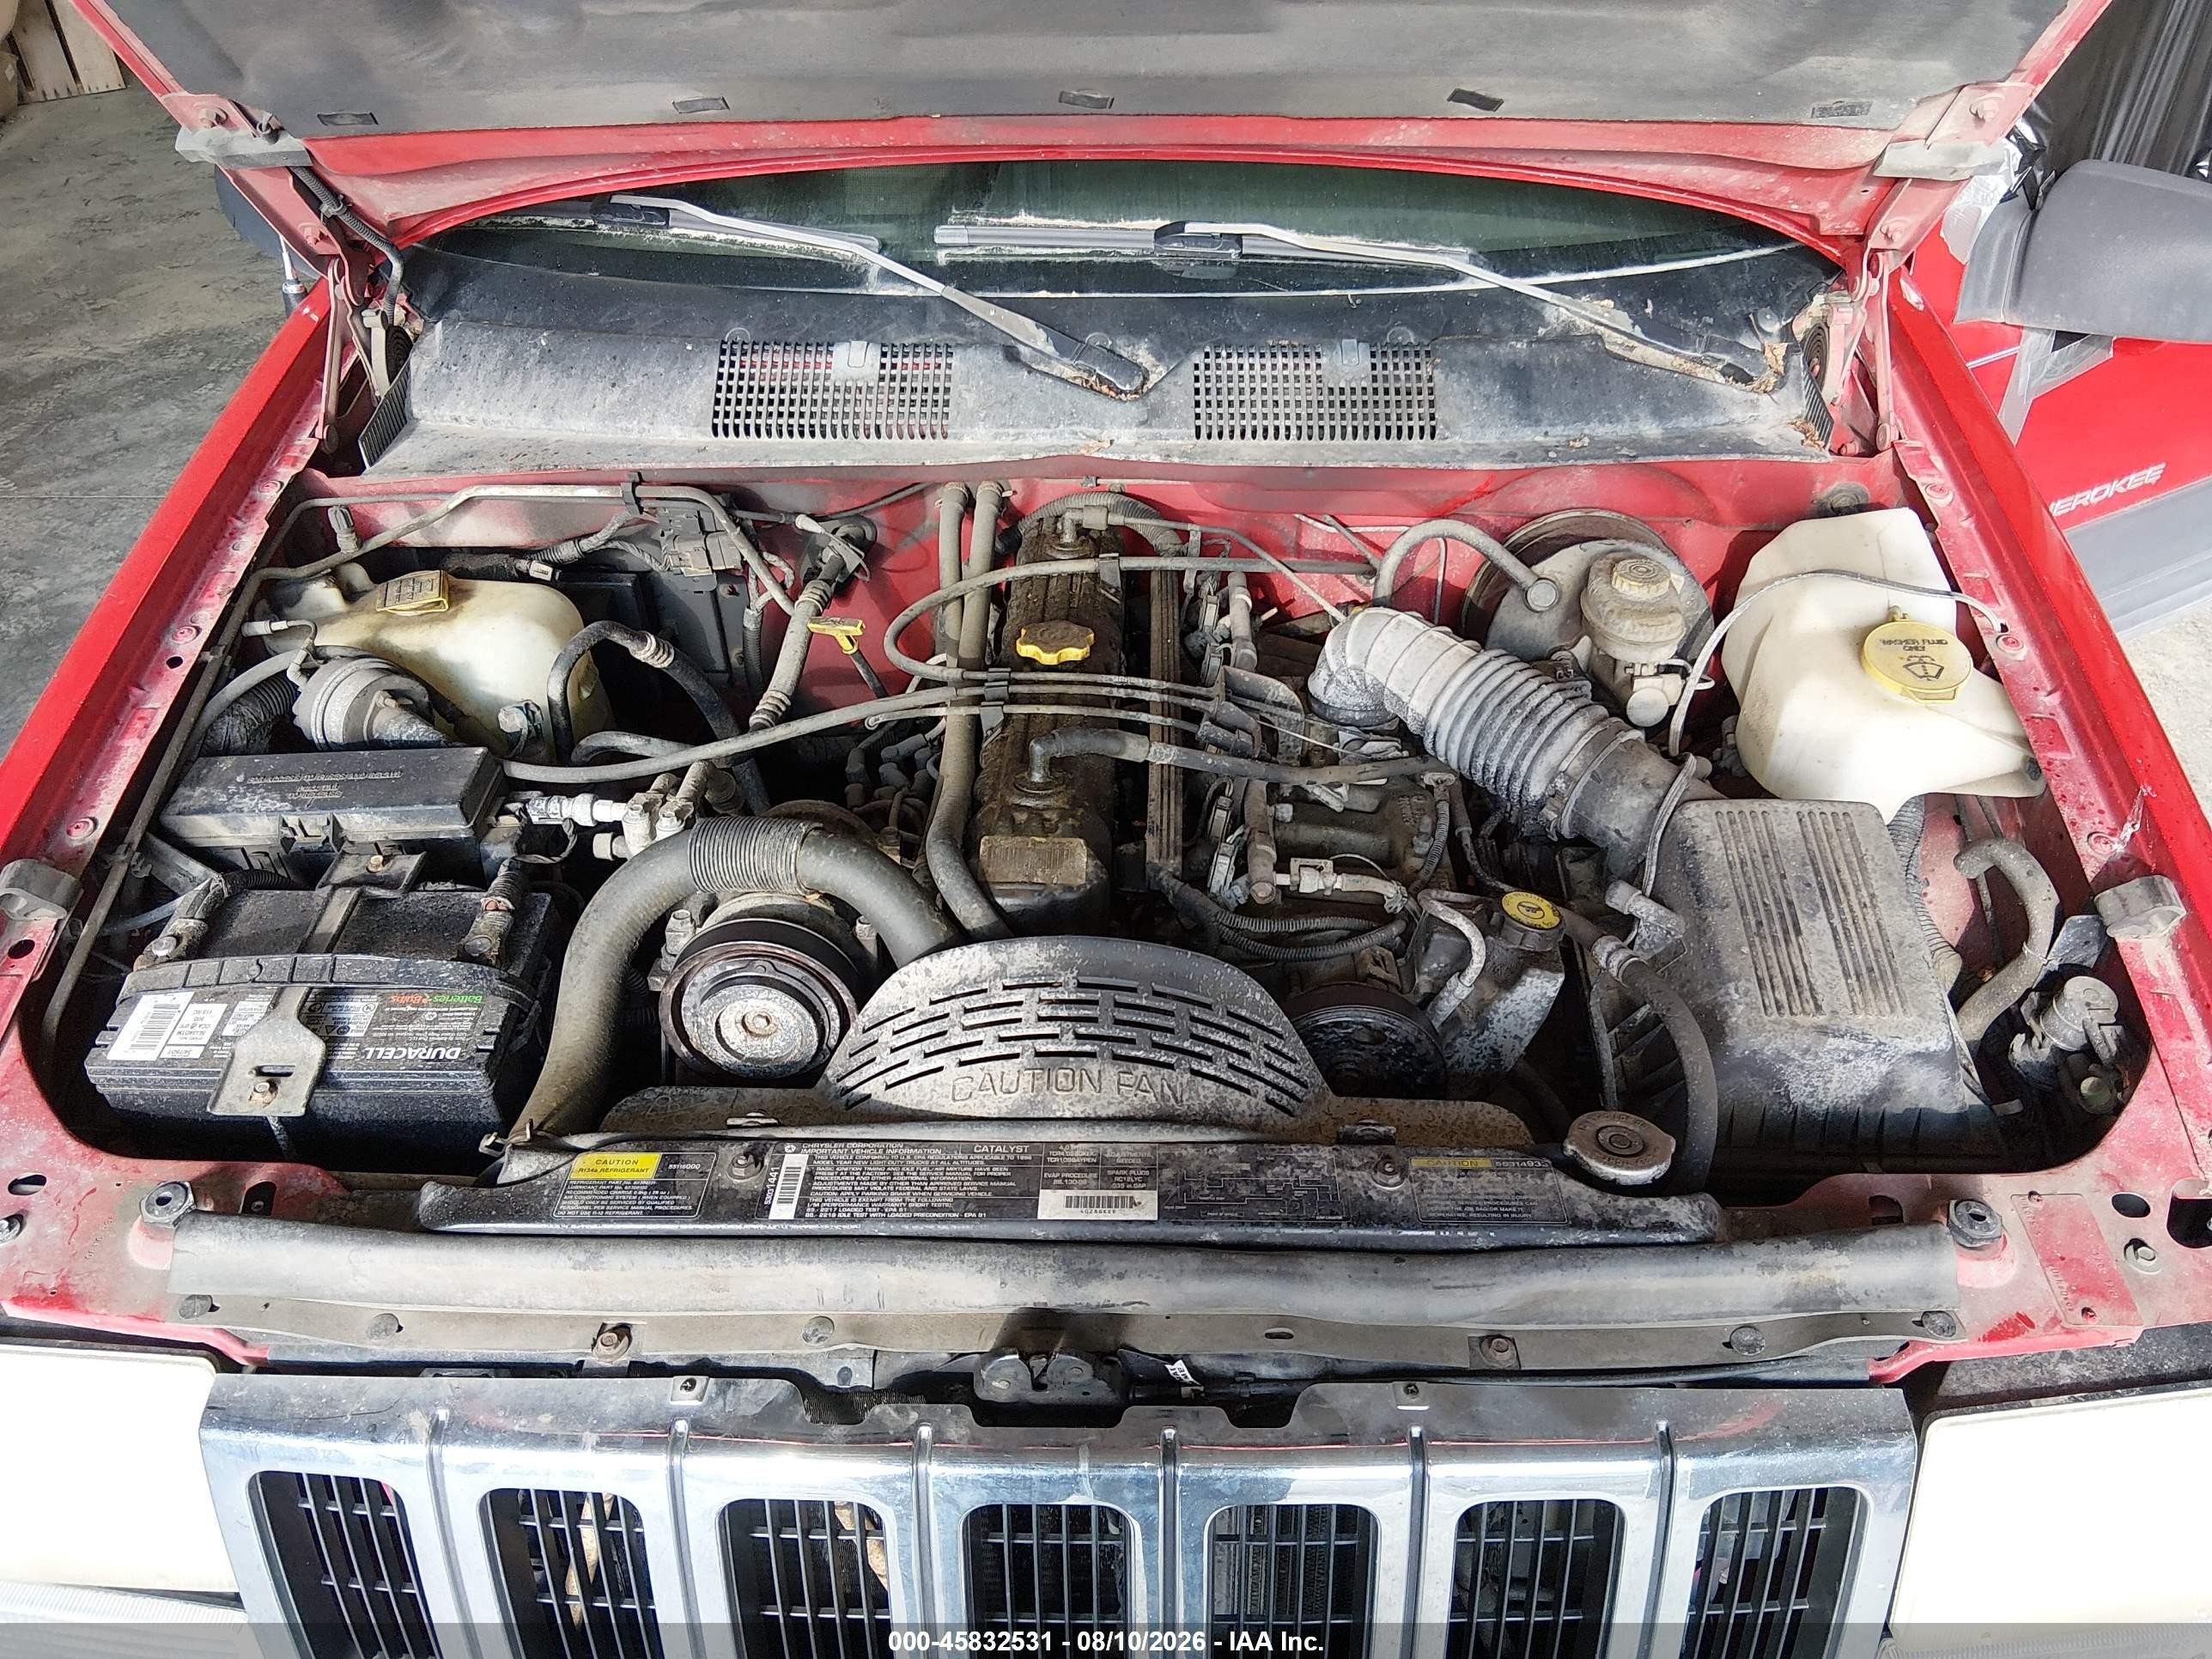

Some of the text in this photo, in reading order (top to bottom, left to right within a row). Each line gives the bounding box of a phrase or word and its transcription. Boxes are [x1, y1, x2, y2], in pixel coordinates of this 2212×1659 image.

[433, 994, 483, 1004] Batteries
[364, 1047, 462, 1060] DURACELL
[951, 1067, 1183, 1105] CAUTION FAN
